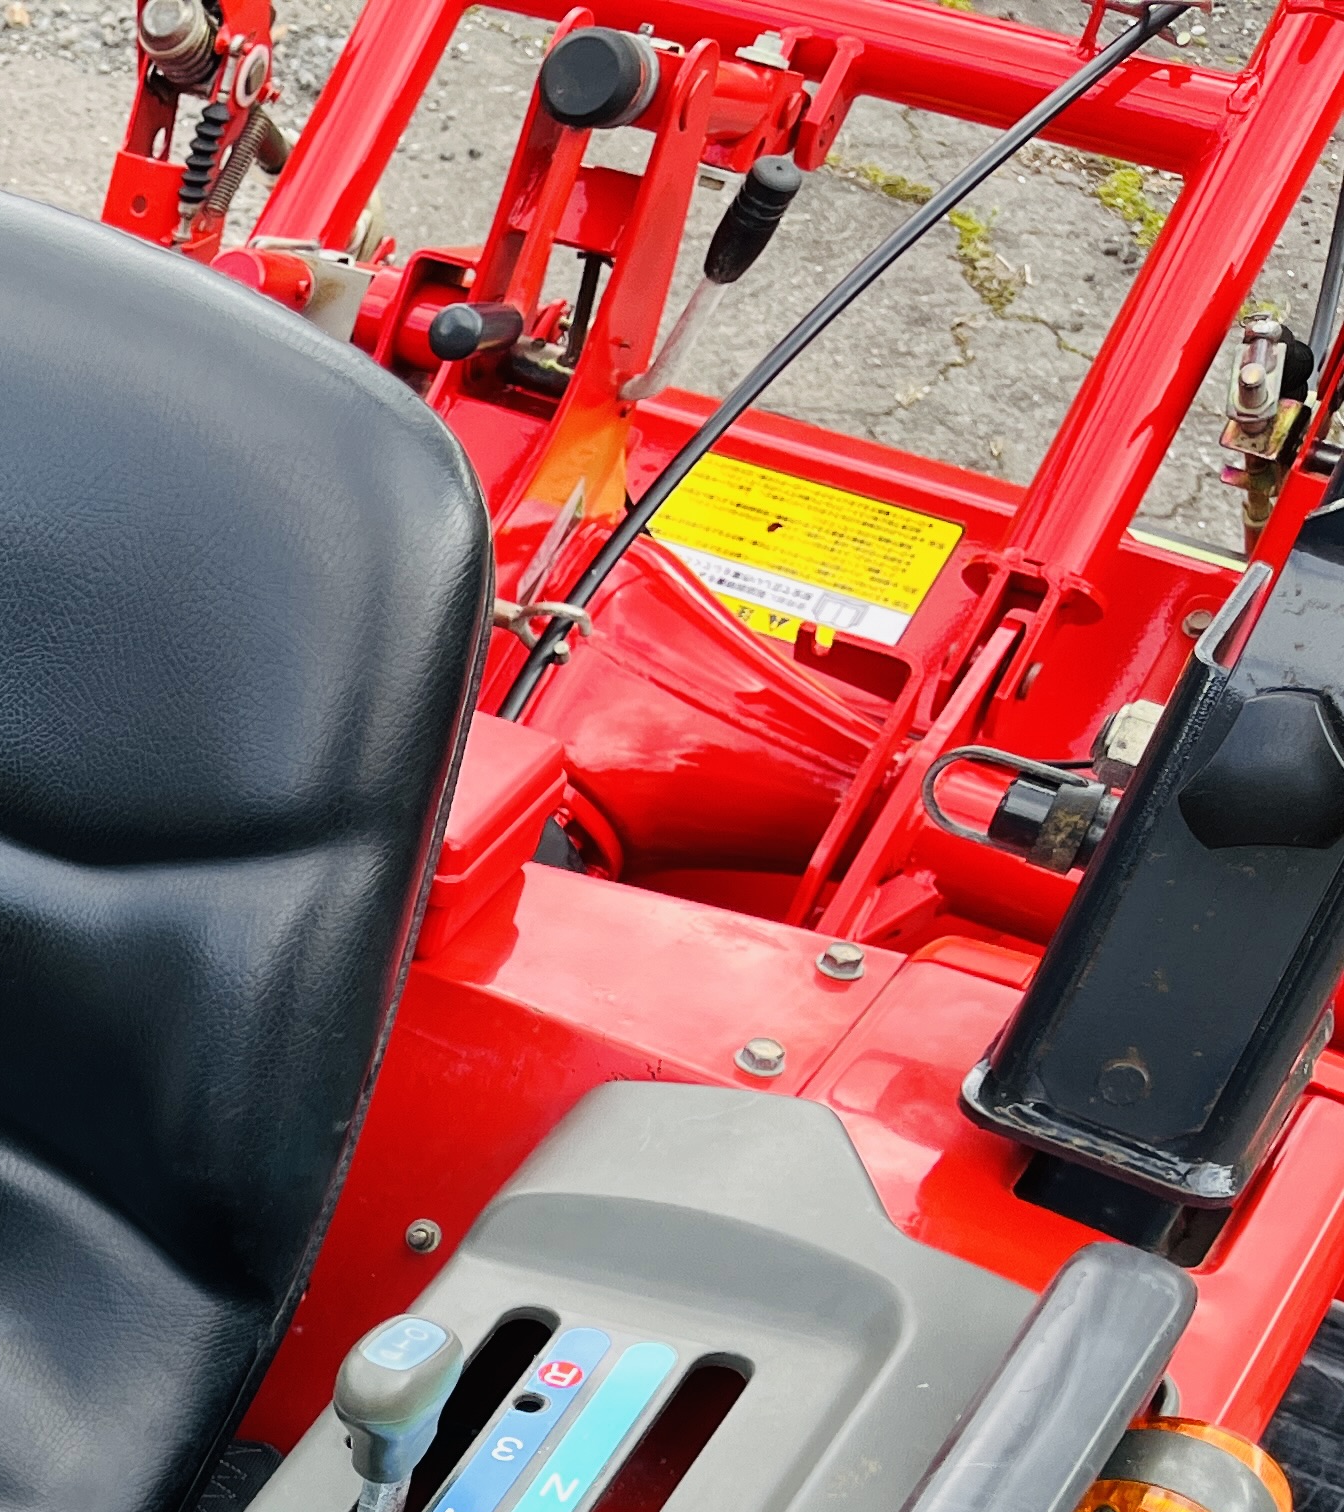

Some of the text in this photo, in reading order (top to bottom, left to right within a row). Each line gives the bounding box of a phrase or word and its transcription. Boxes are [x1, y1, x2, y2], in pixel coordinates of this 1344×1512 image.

[544, 1363, 585, 1388] R
[491, 1435, 524, 1462] 3
[540, 1473, 579, 1502] N
